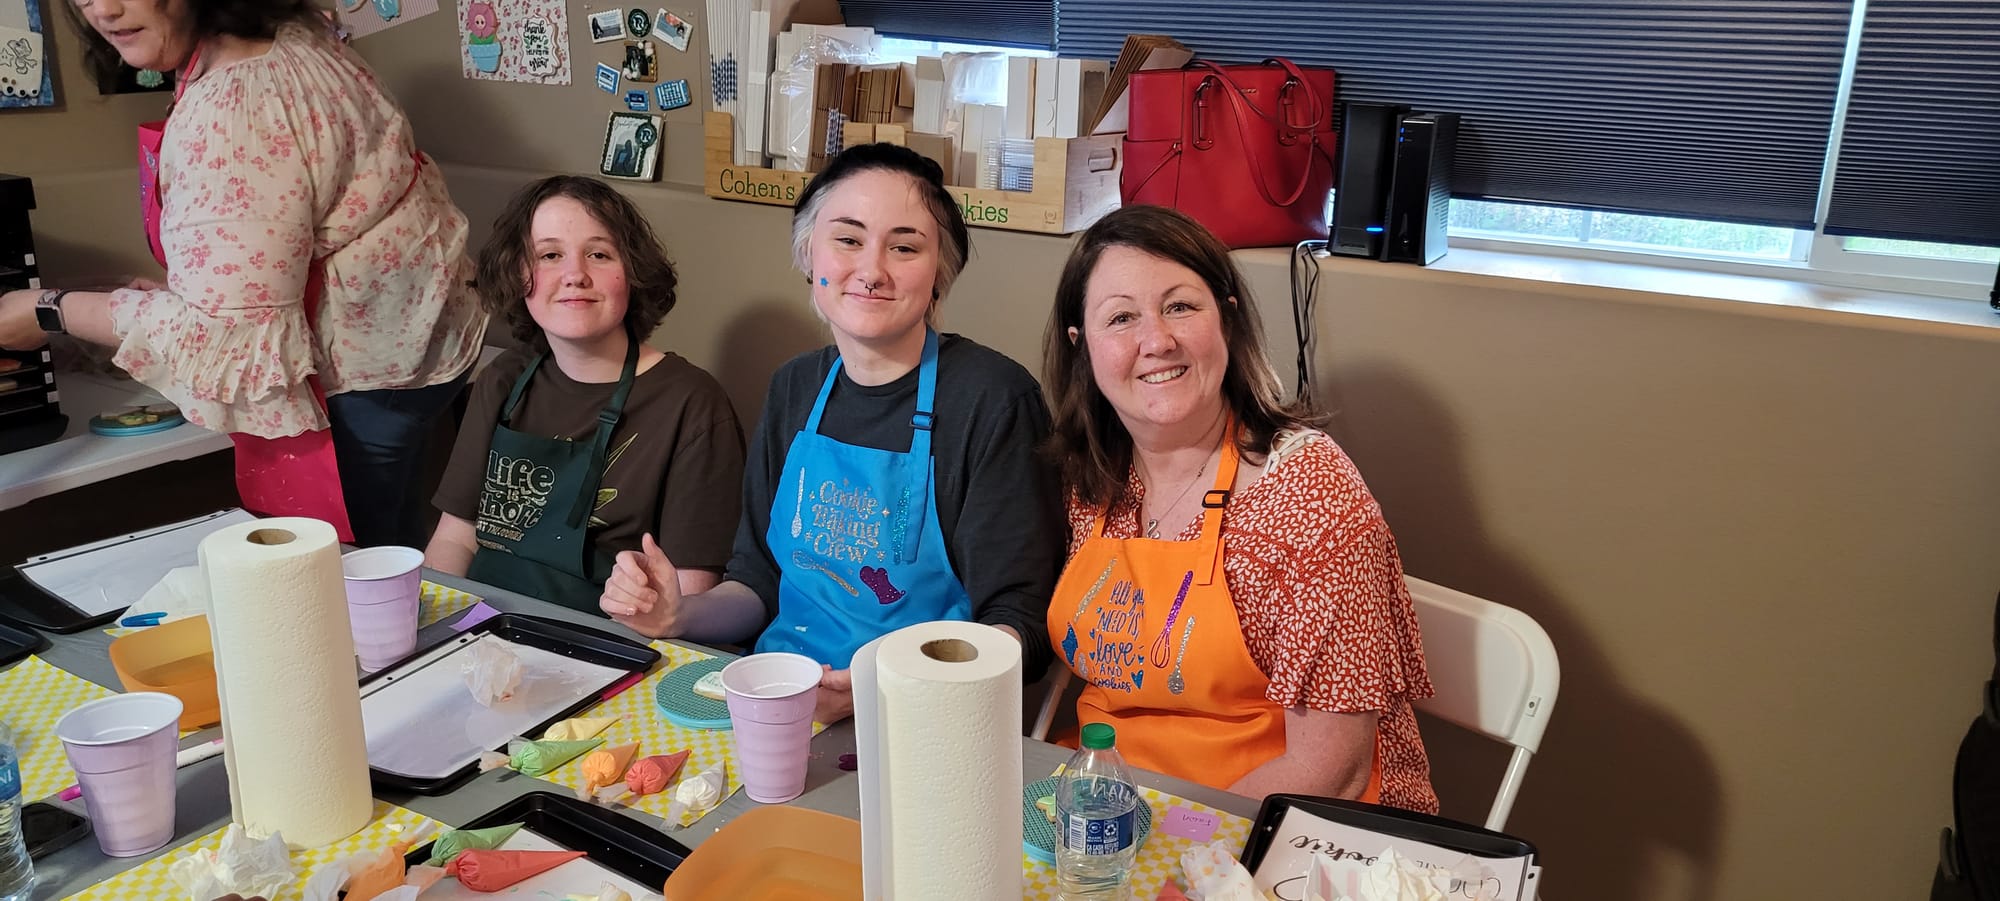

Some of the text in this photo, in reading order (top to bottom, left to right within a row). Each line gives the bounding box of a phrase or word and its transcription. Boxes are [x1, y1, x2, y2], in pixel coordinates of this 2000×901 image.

[720, 168, 795, 200] Cohen's
[486, 450, 555, 495] Life
[820, 480, 878, 520] Cookie
[811, 504, 880, 548] Baking
[814, 532, 868, 563] Crew
[1108, 580, 1132, 606] All
[1096, 634, 1136, 667] love
[1093, 677, 1132, 693] cookies
[1099, 664, 1123, 677] AND
[1288, 835, 1379, 867] ookie
